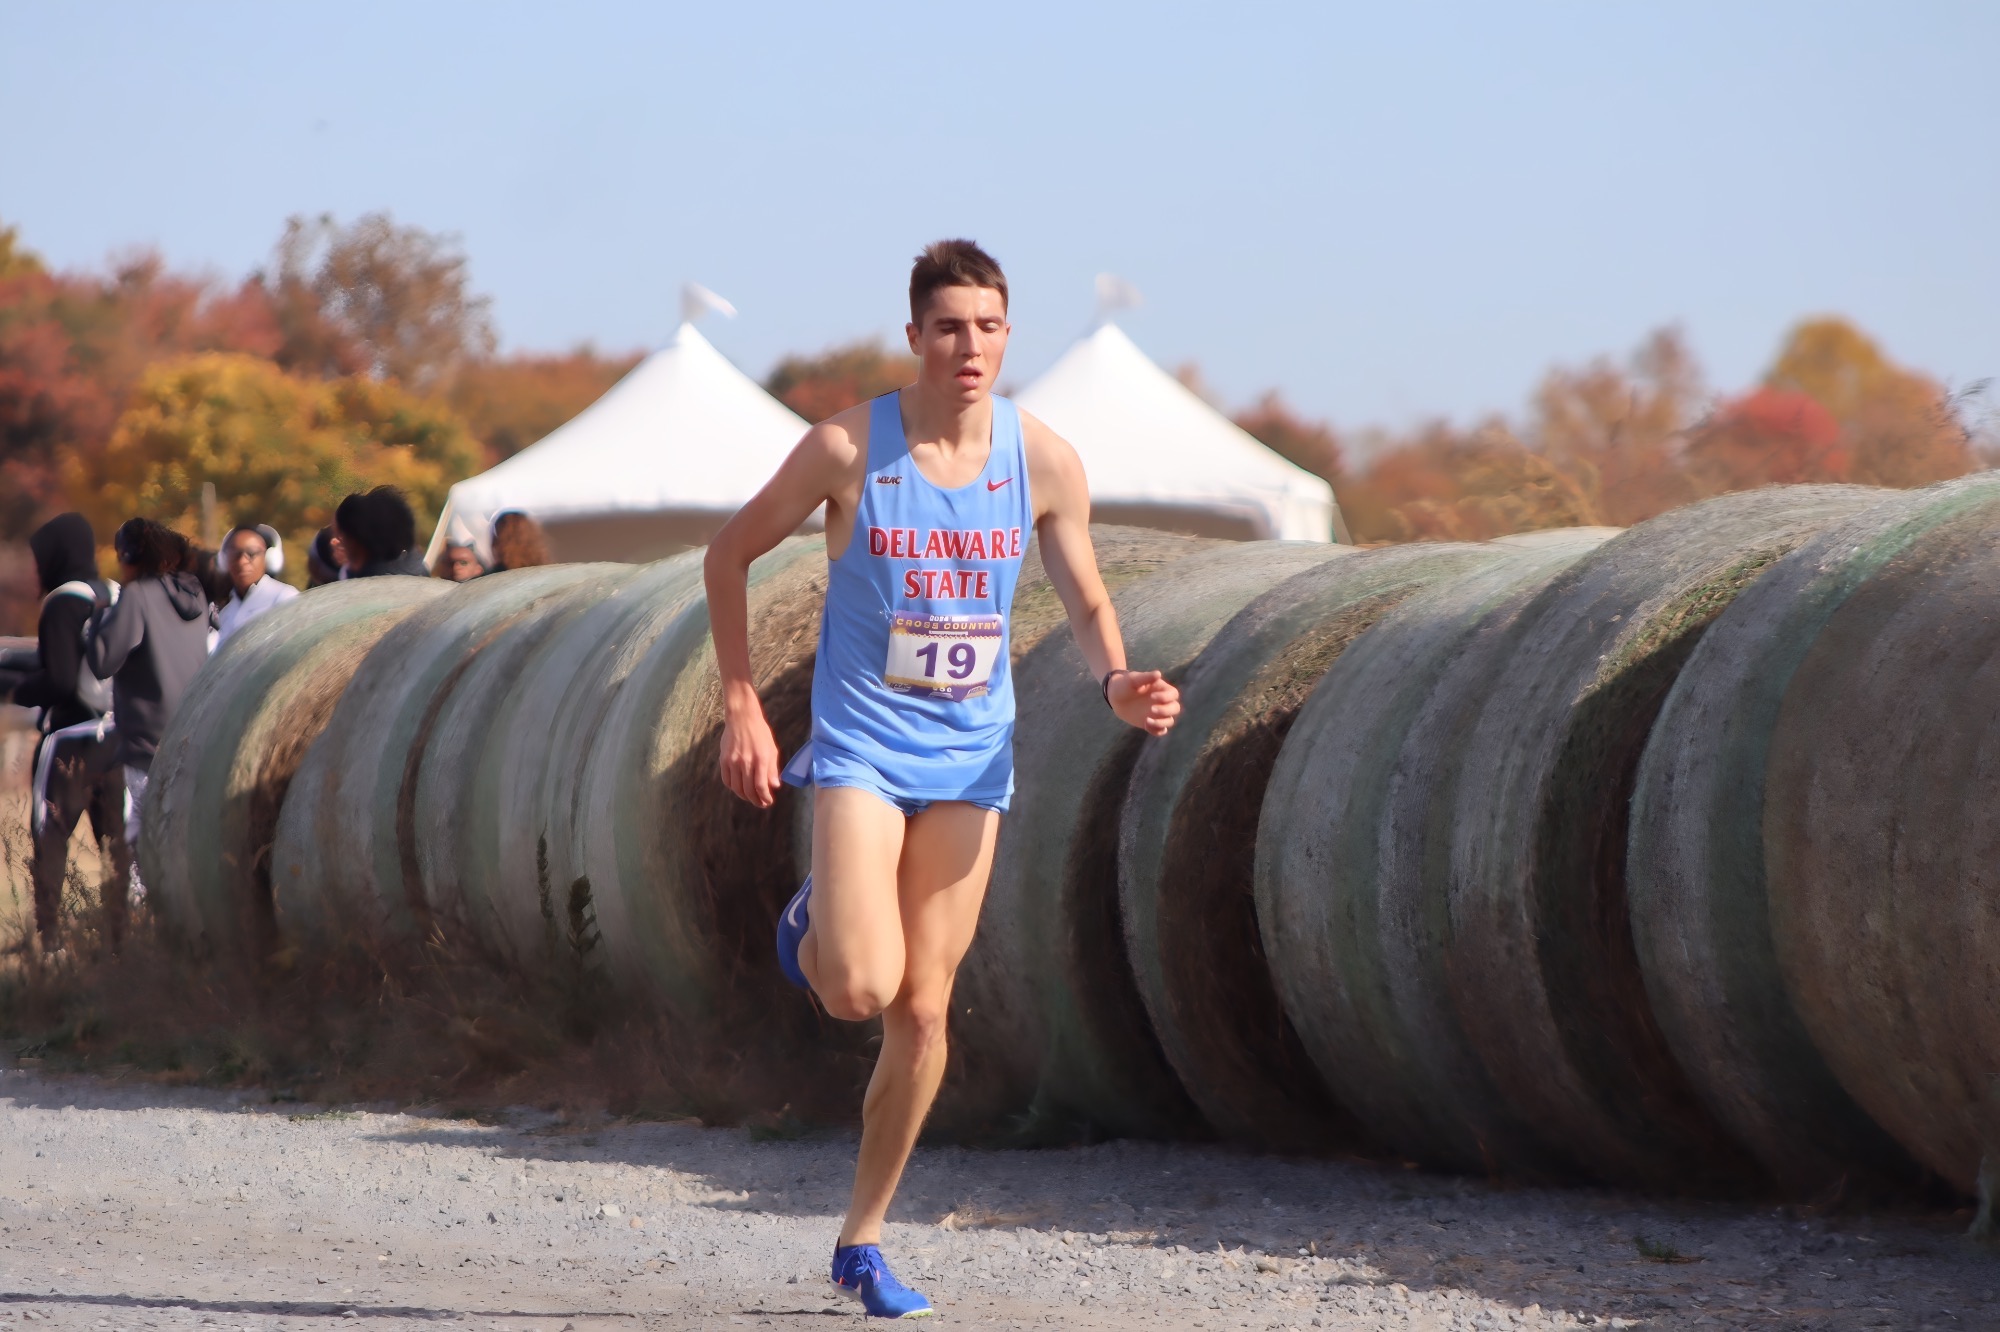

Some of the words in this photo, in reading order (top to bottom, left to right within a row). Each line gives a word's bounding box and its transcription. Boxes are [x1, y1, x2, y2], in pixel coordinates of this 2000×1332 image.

[868, 526, 1021, 560] DELAWARE
[903, 569, 989, 599] STATE
[896, 618, 939, 630] CROSS
[943, 621, 998, 630] COUNTRY
[916, 642, 976, 679] 19
